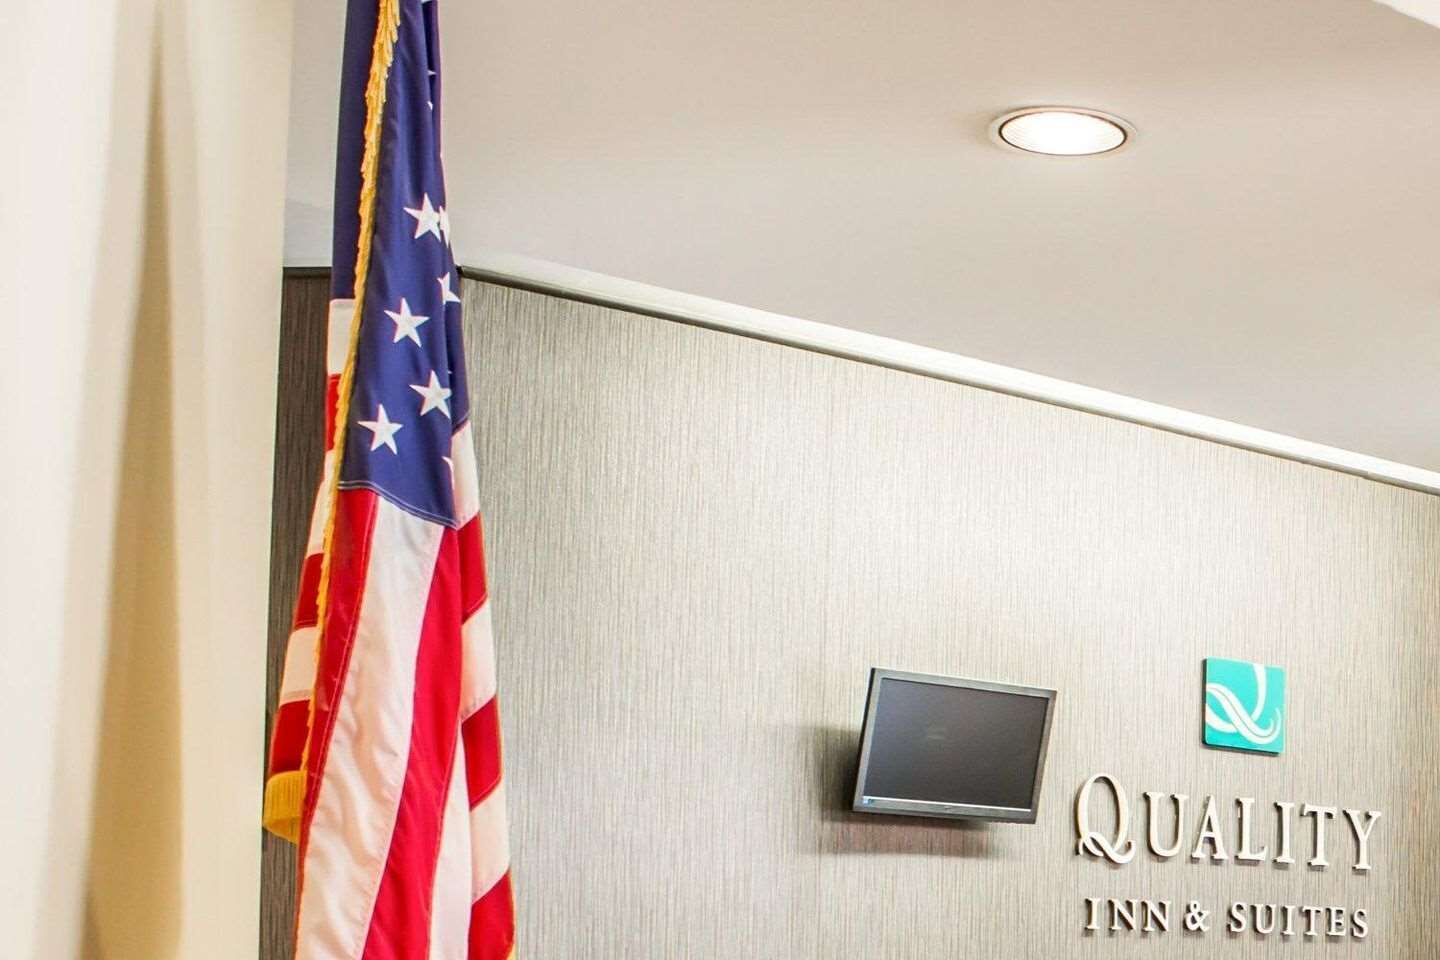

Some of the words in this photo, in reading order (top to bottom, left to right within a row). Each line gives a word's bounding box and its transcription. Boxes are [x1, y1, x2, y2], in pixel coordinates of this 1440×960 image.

[1075, 772, 1382, 871] QUALITY
[1085, 897, 1172, 932] INN
[1183, 900, 1211, 933] &
[1228, 902, 1370, 939] SUITES
